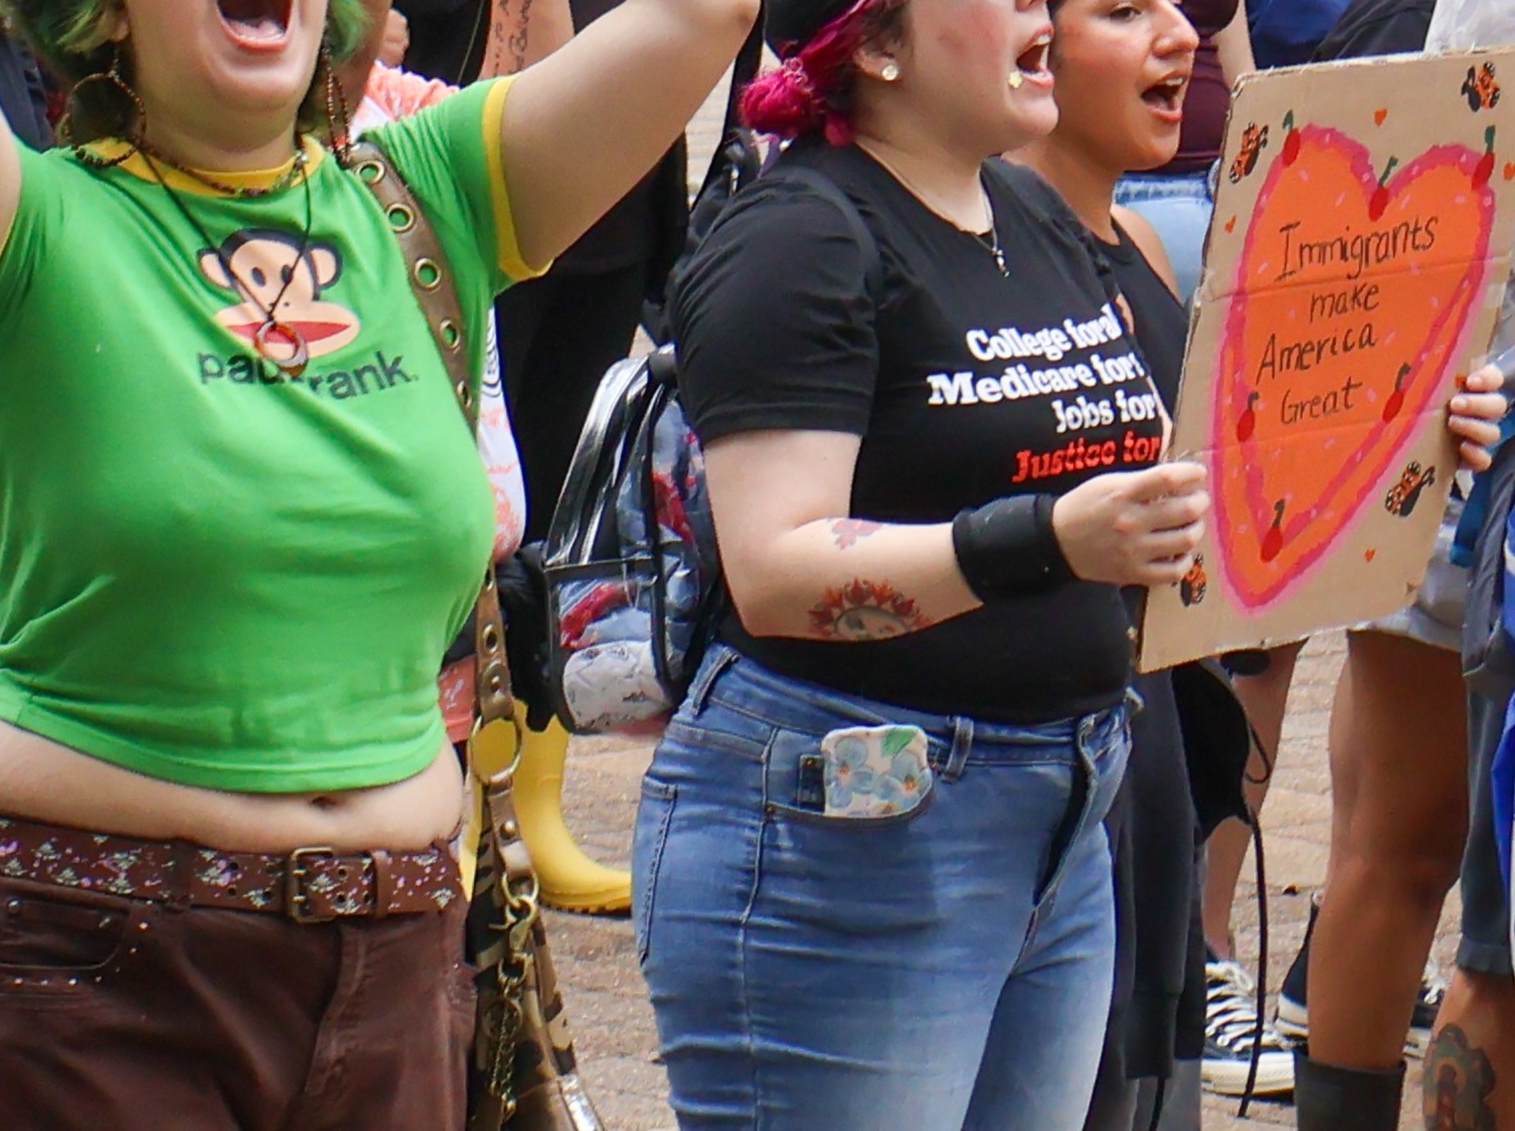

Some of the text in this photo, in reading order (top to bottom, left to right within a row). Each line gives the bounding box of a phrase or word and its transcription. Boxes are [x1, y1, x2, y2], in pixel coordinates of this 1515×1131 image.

[1273, 214, 1440, 283] Immigrants
[1308, 279, 1382, 325] make
[966, 325, 1072, 362] College
[1256, 320, 1379, 386] America
[925, 362, 1097, 406] Medicare
[1280, 375, 1364, 426] Great
[1051, 388, 1158, 434] Jobs for
[1011, 430, 1161, 484] Justice for
